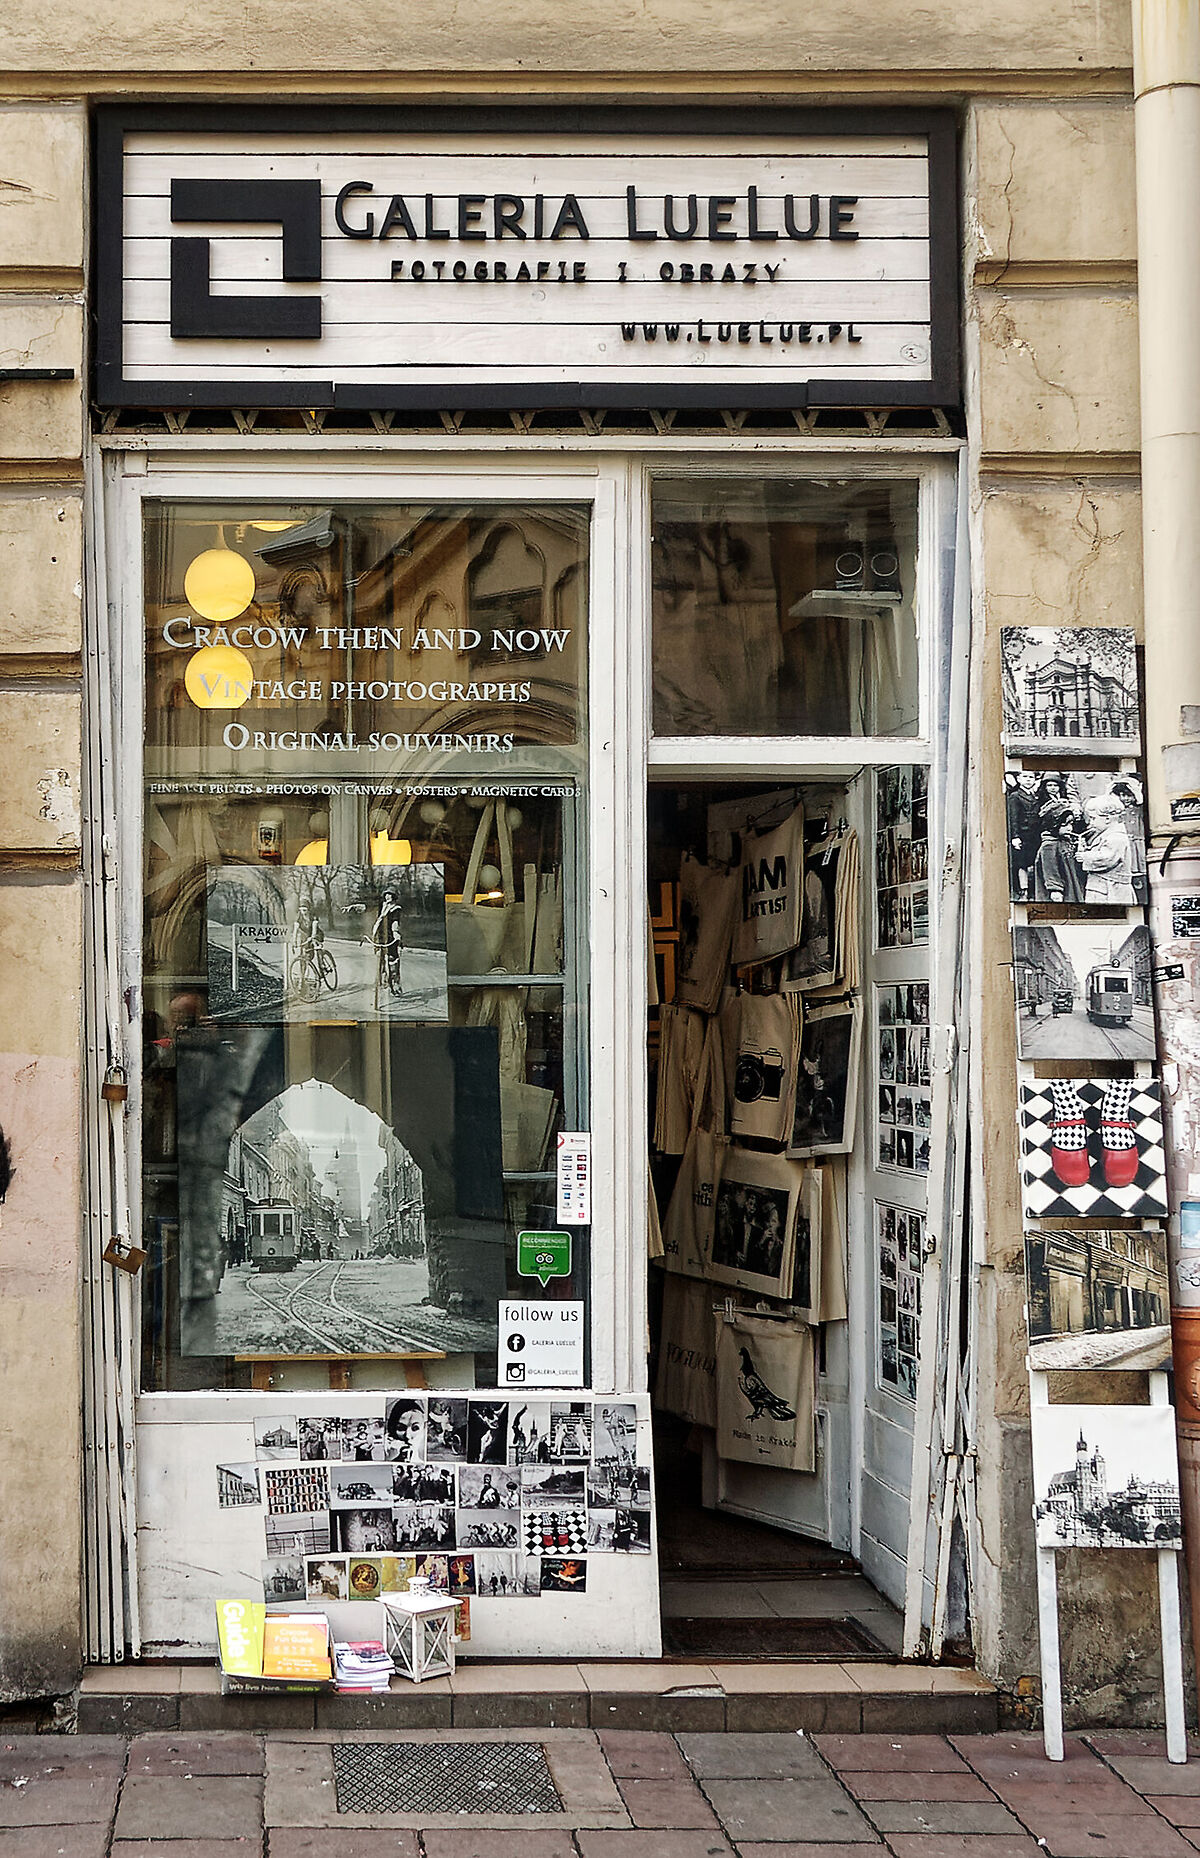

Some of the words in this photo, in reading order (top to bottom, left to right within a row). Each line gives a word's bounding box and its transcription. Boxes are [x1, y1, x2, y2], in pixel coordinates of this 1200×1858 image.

[334, 180, 590, 241] GALERIA
[626, 185, 860, 241] LUELUE
[390, 259, 587, 282] FOTOGRAFIE
[618, 261, 628, 282] I
[659, 261, 781, 283] OBRAZY
[620, 319, 862, 344] WWW.LUELUE.PL
[162, 616, 306, 652] CRACOW
[315, 626, 402, 651] THEN
[412, 627, 482, 652] AND
[489, 628, 572, 653] NOW
[198, 673, 323, 702] VINTAGE
[330, 679, 533, 703] PHOTOGRAPHS
[222, 722, 360, 753] ORIGINAL
[368, 731, 515, 754] SOUVENIRS
[266, 783, 317, 795] PHOTOS
[321, 784, 341, 795] ON
[344, 784, 393, 796] CANVAS
[406, 784, 458, 797] POSTERS
[470, 785, 538, 797] MAGNETIC
[541, 785, 581, 797] CARDS
[239, 926, 288, 938] KRAKOW
[505, 1306, 553, 1321] follow
[561, 1310, 579, 1321] us
[223, 1602, 250, 1659] Guide
